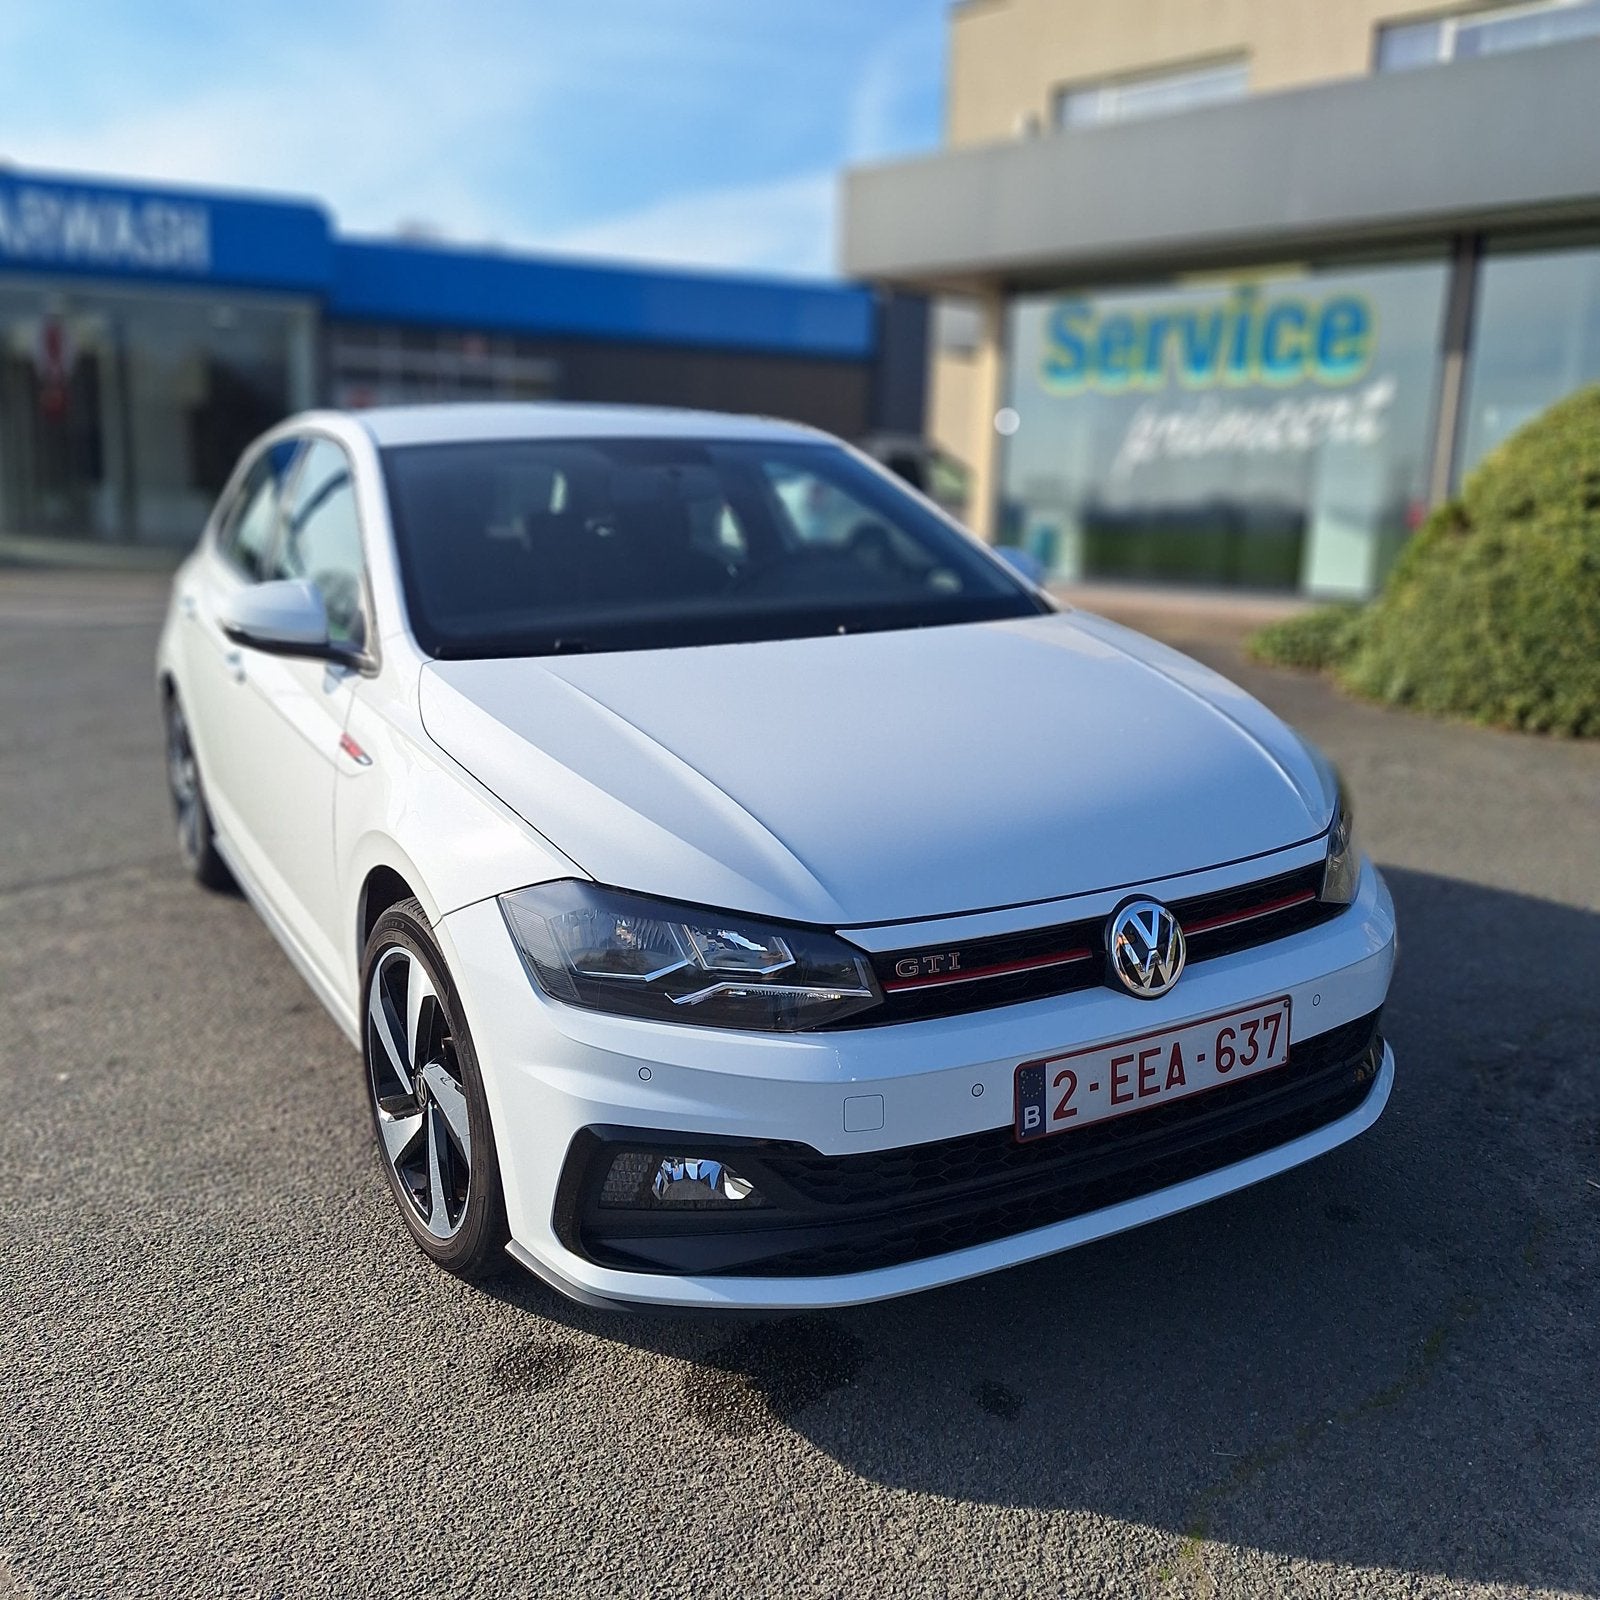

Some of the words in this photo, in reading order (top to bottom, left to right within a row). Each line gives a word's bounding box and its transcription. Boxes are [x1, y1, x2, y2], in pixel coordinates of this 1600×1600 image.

[1041, 281, 1375, 391] Service
[895, 951, 961, 978] GTI
[1053, 1012, 1283, 1121] 2-EEA-637
[1024, 1105, 1041, 1130] B
